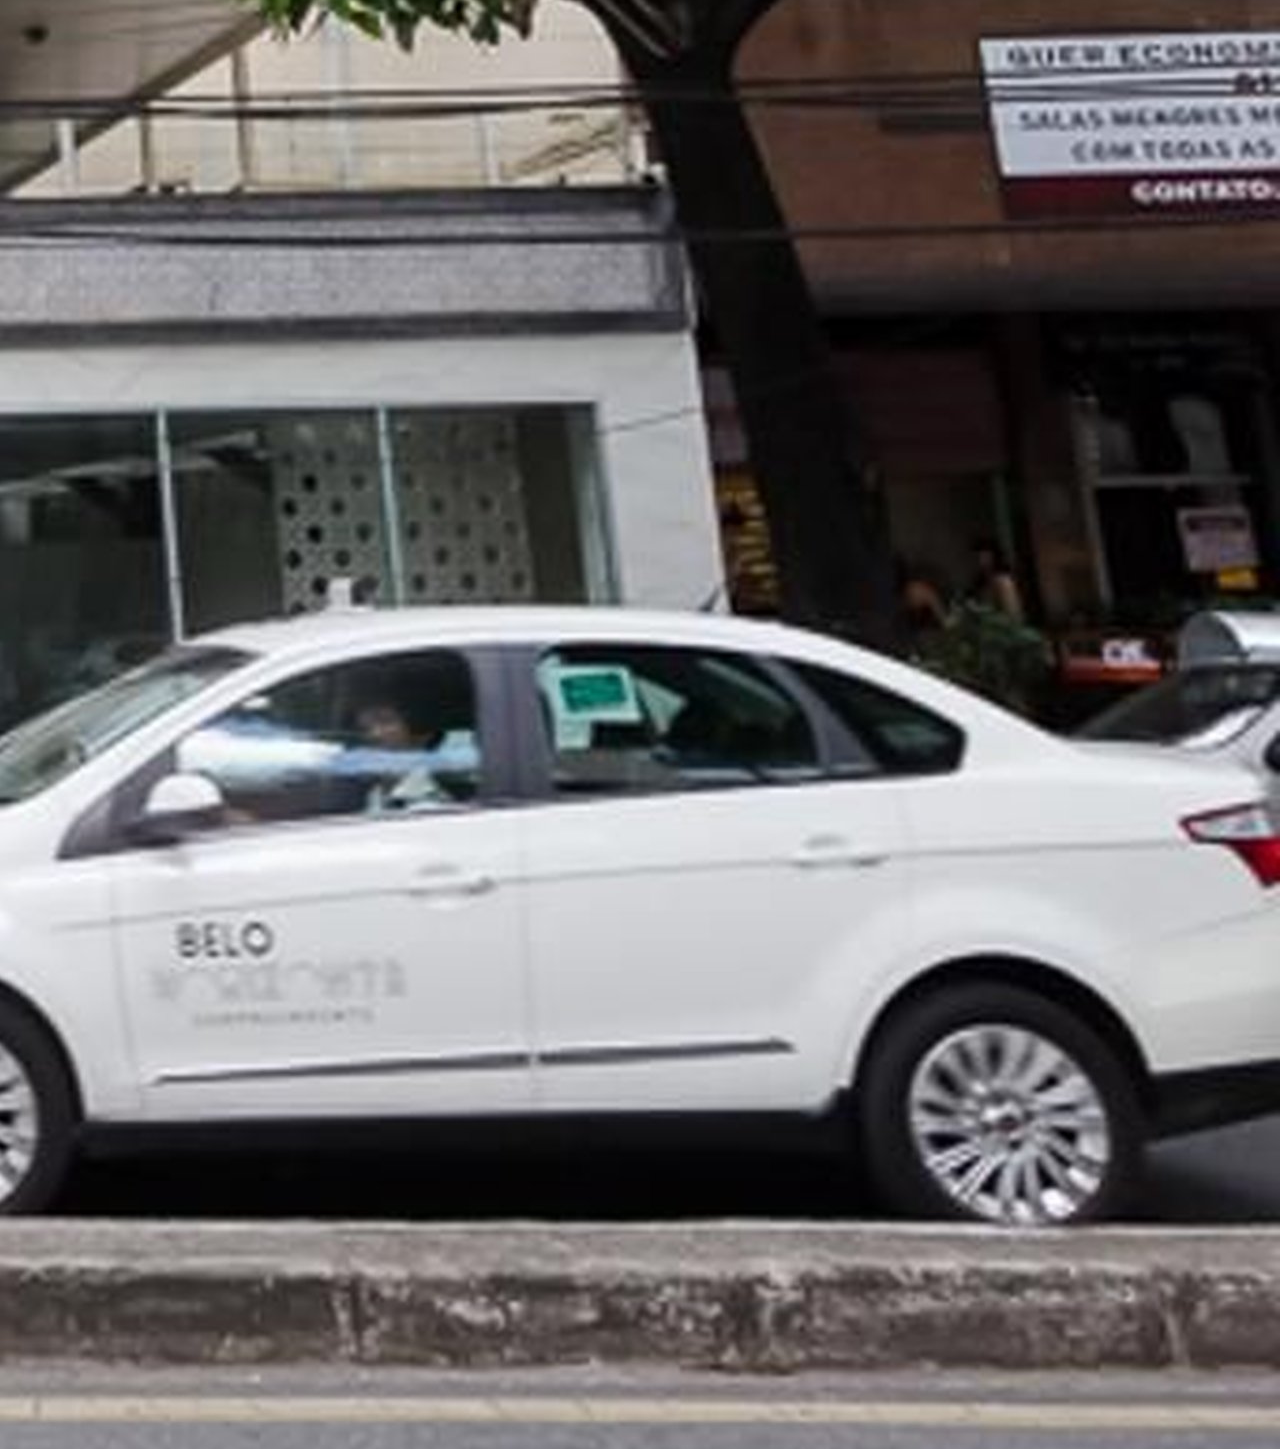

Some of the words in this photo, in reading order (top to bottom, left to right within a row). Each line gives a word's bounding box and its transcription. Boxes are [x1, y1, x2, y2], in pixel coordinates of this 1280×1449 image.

[1005, 43, 1106, 65] QUER
[1019, 109, 1105, 131] SALAS
[1111, 107, 1241, 127] MENORES
[1071, 142, 1134, 163] COM
[1140, 140, 1231, 161] TODAS
[1240, 139, 1275, 158] AS
[176, 921, 273, 958] BELO
